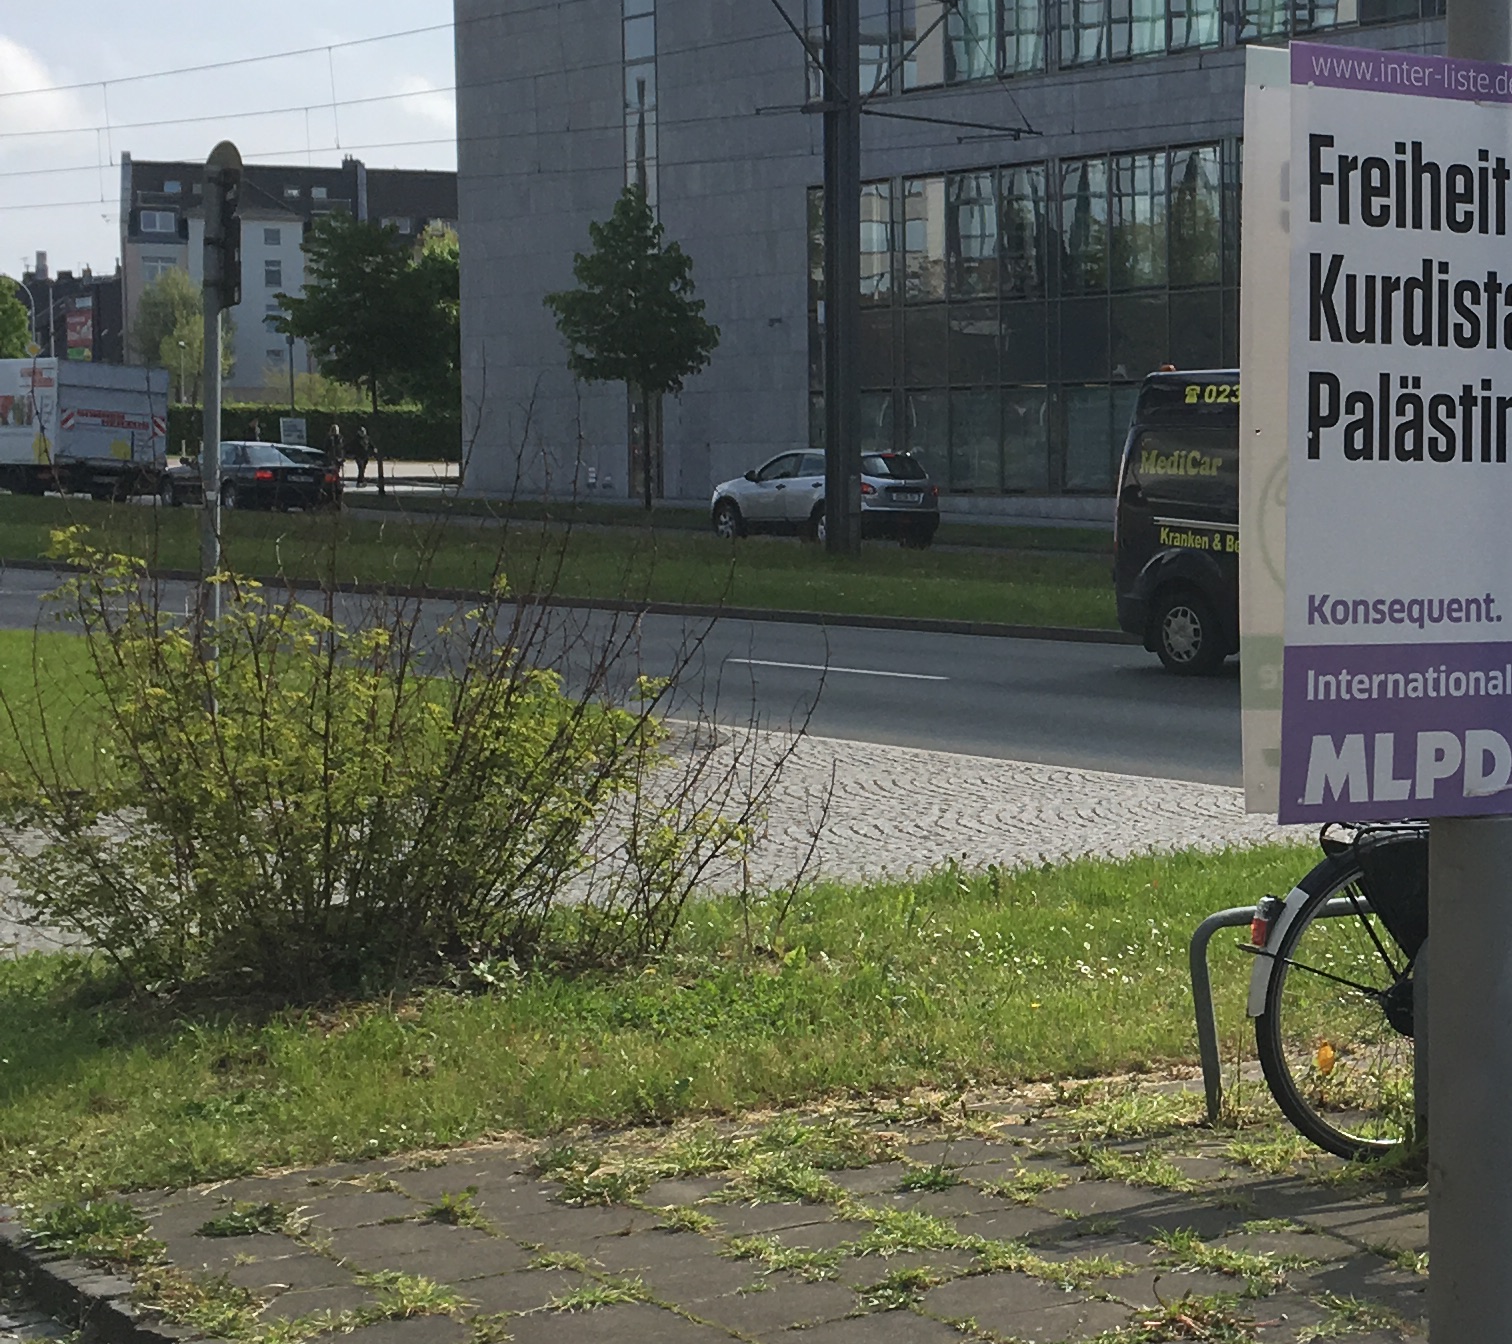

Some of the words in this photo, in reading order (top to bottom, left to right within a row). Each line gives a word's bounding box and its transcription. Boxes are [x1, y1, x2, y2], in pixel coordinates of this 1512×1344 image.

[1308, 133, 1511, 236] Freiheit
[1139, 449, 1222, 476] MediCar
[1160, 526, 1209, 550] Kranken
[1307, 592, 1503, 630] Konsequent.
[1303, 728, 1512, 806] MLPD
